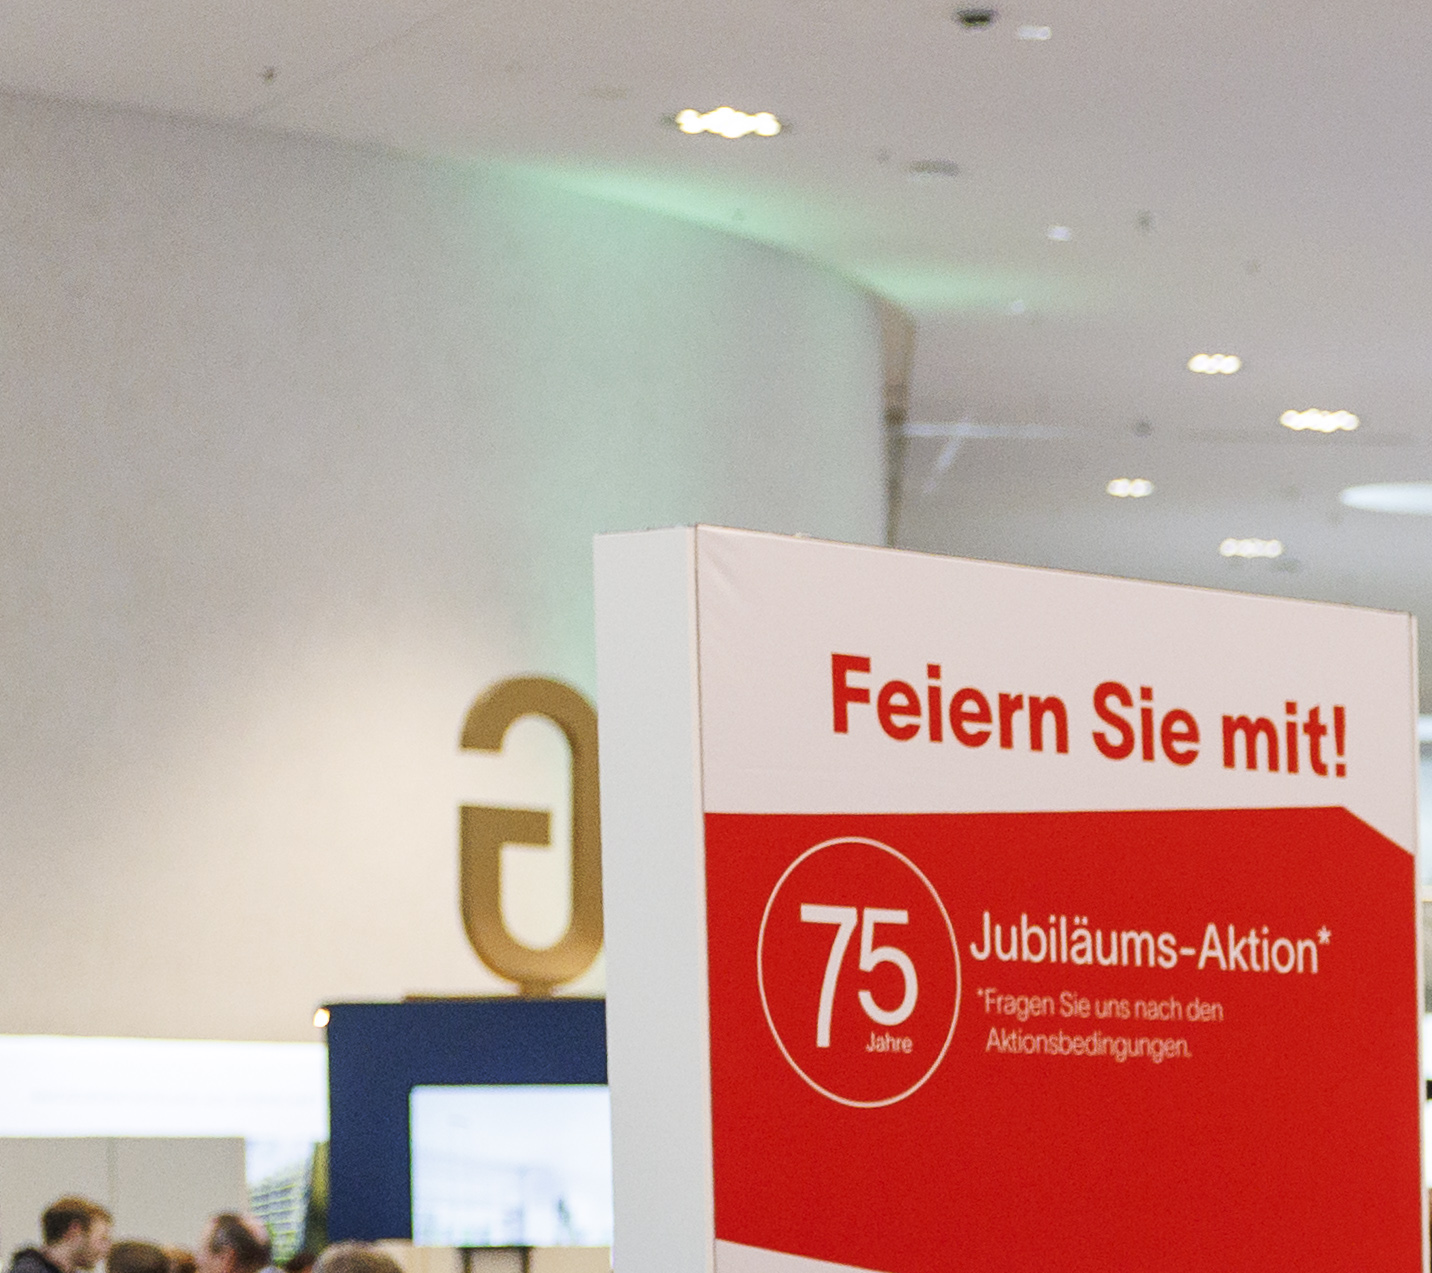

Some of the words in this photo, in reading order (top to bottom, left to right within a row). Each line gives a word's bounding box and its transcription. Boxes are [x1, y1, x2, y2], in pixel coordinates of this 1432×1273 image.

[831, 652, 1069, 755] Feiern
[1091, 680, 1200, 768] Sie
[1221, 700, 1348, 779] mit!
[801, 903, 919, 1048] 75
[1059, 990, 1092, 1020] Sie
[1095, 996, 1132, 1021] uns
[1134, 996, 1183, 1023] nach
[1186, 997, 1225, 1023] den
[866, 1031, 914, 1055] Jahre
[985, 1026, 1193, 1065] Aktionsbedingungen.
